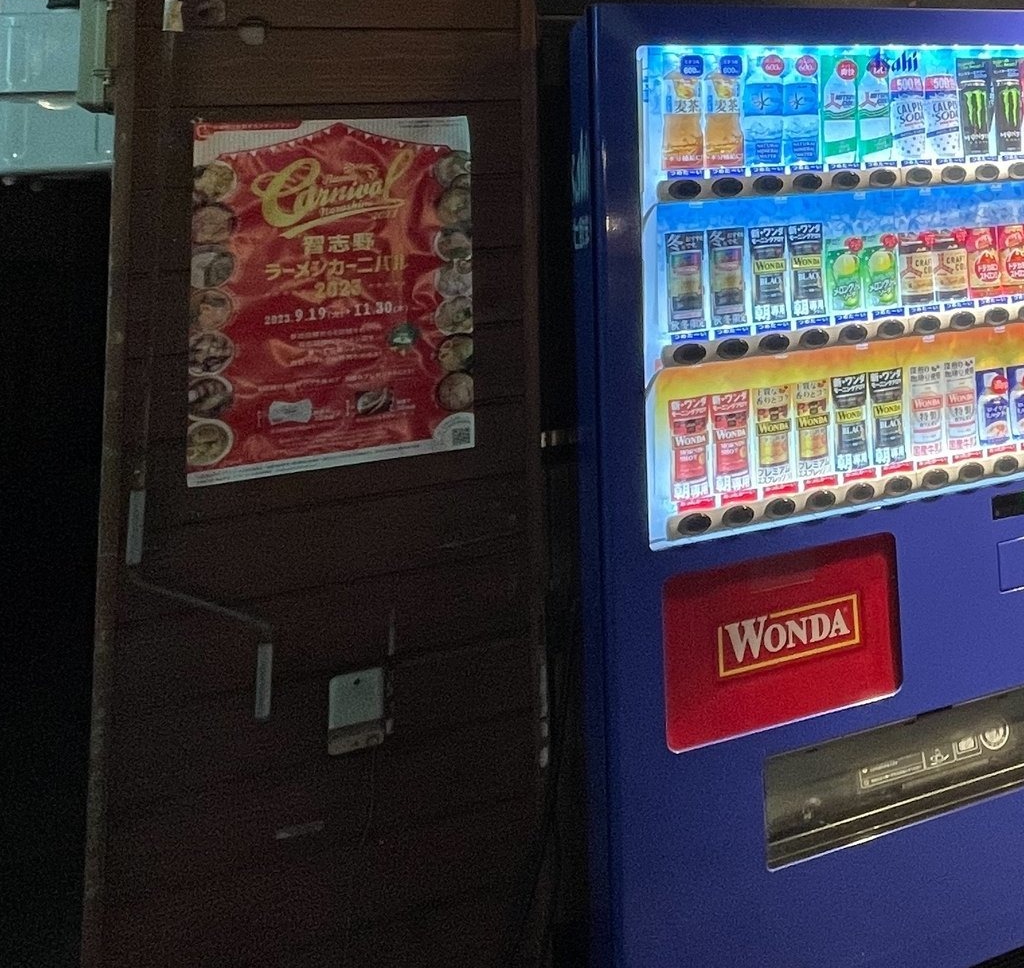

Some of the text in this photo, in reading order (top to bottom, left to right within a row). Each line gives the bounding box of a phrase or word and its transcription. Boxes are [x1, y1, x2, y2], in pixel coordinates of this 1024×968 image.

[250, 147, 415, 230] Carnival
[303, 232, 375, 254] 習志野
[265, 254, 406, 281] ラーメンカーニバル
[758, 421, 790, 433] WONDA
[799, 415, 828, 427] WONDA
[675, 434, 706, 447] WONDA
[716, 429, 746, 441] WONDA
[723, 607, 850, 664] WONDA
